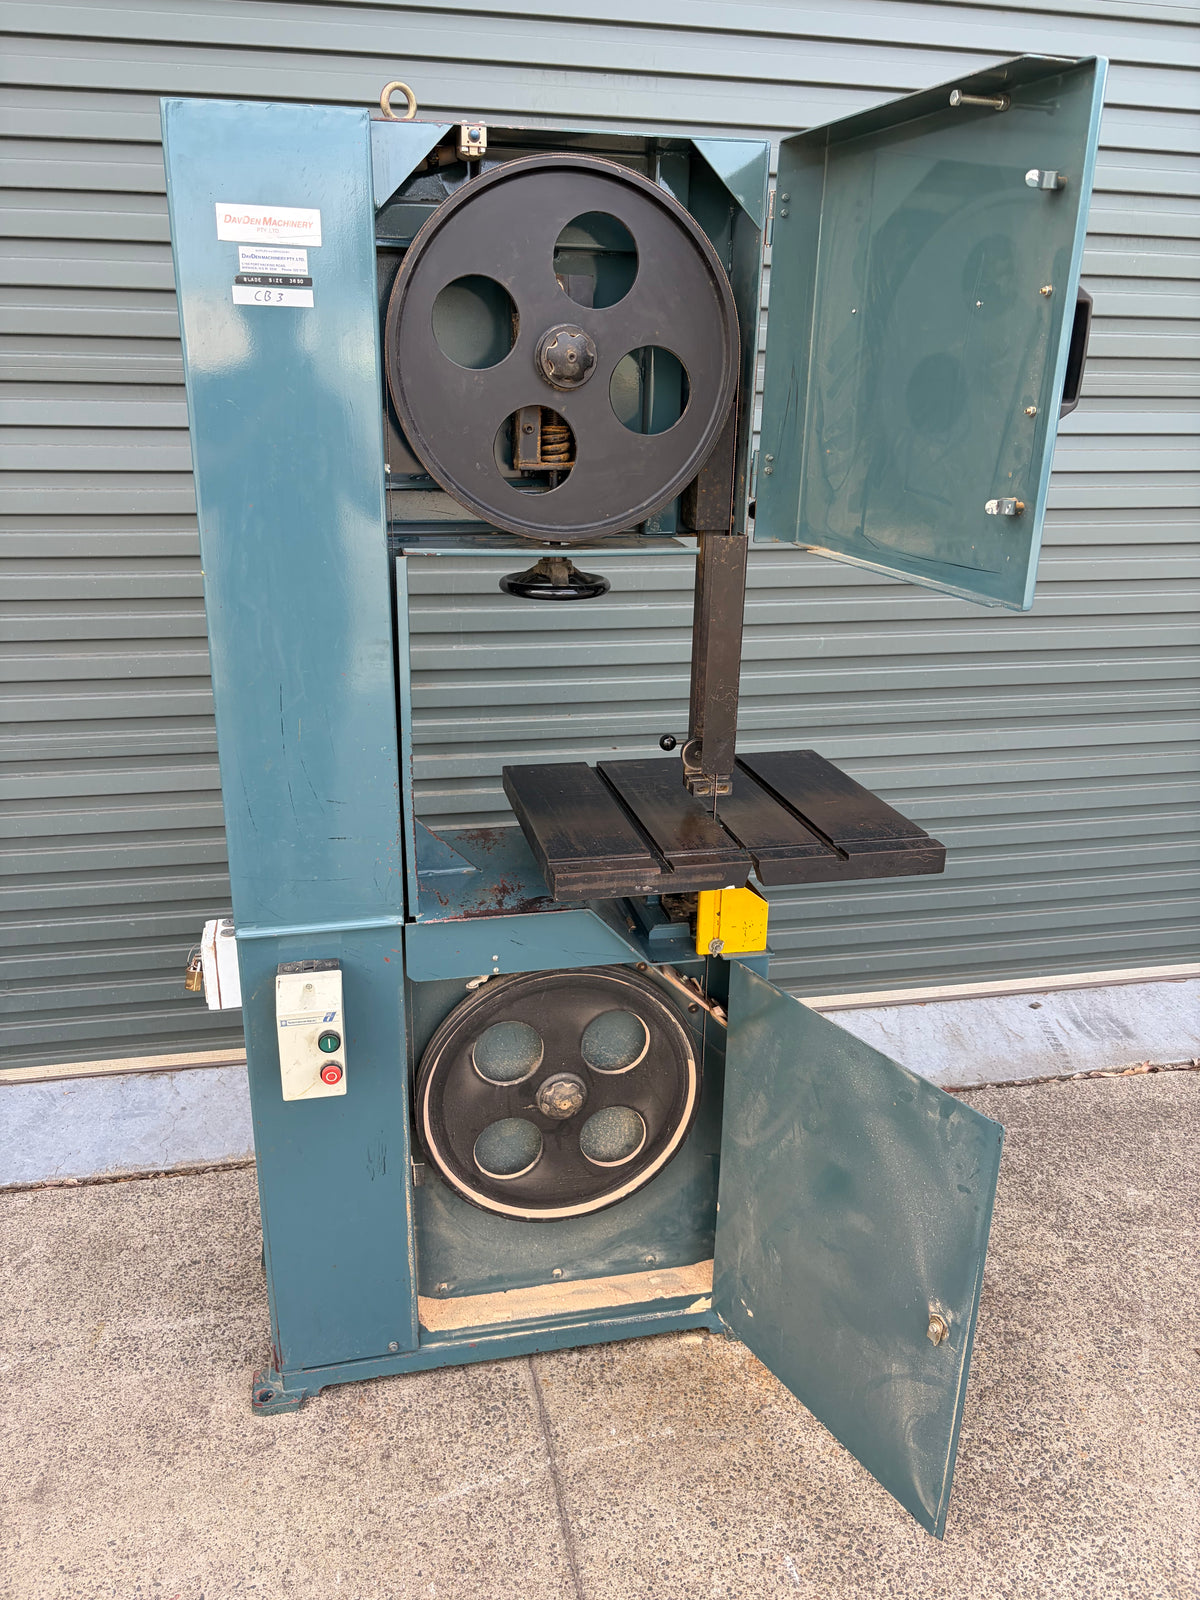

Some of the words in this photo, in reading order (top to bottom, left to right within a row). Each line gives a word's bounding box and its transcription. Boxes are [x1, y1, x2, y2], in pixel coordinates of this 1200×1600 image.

[263, 217, 313, 229] MACHINERY
[254, 290, 272, 302] CB
[276, 293, 285, 303] 3
